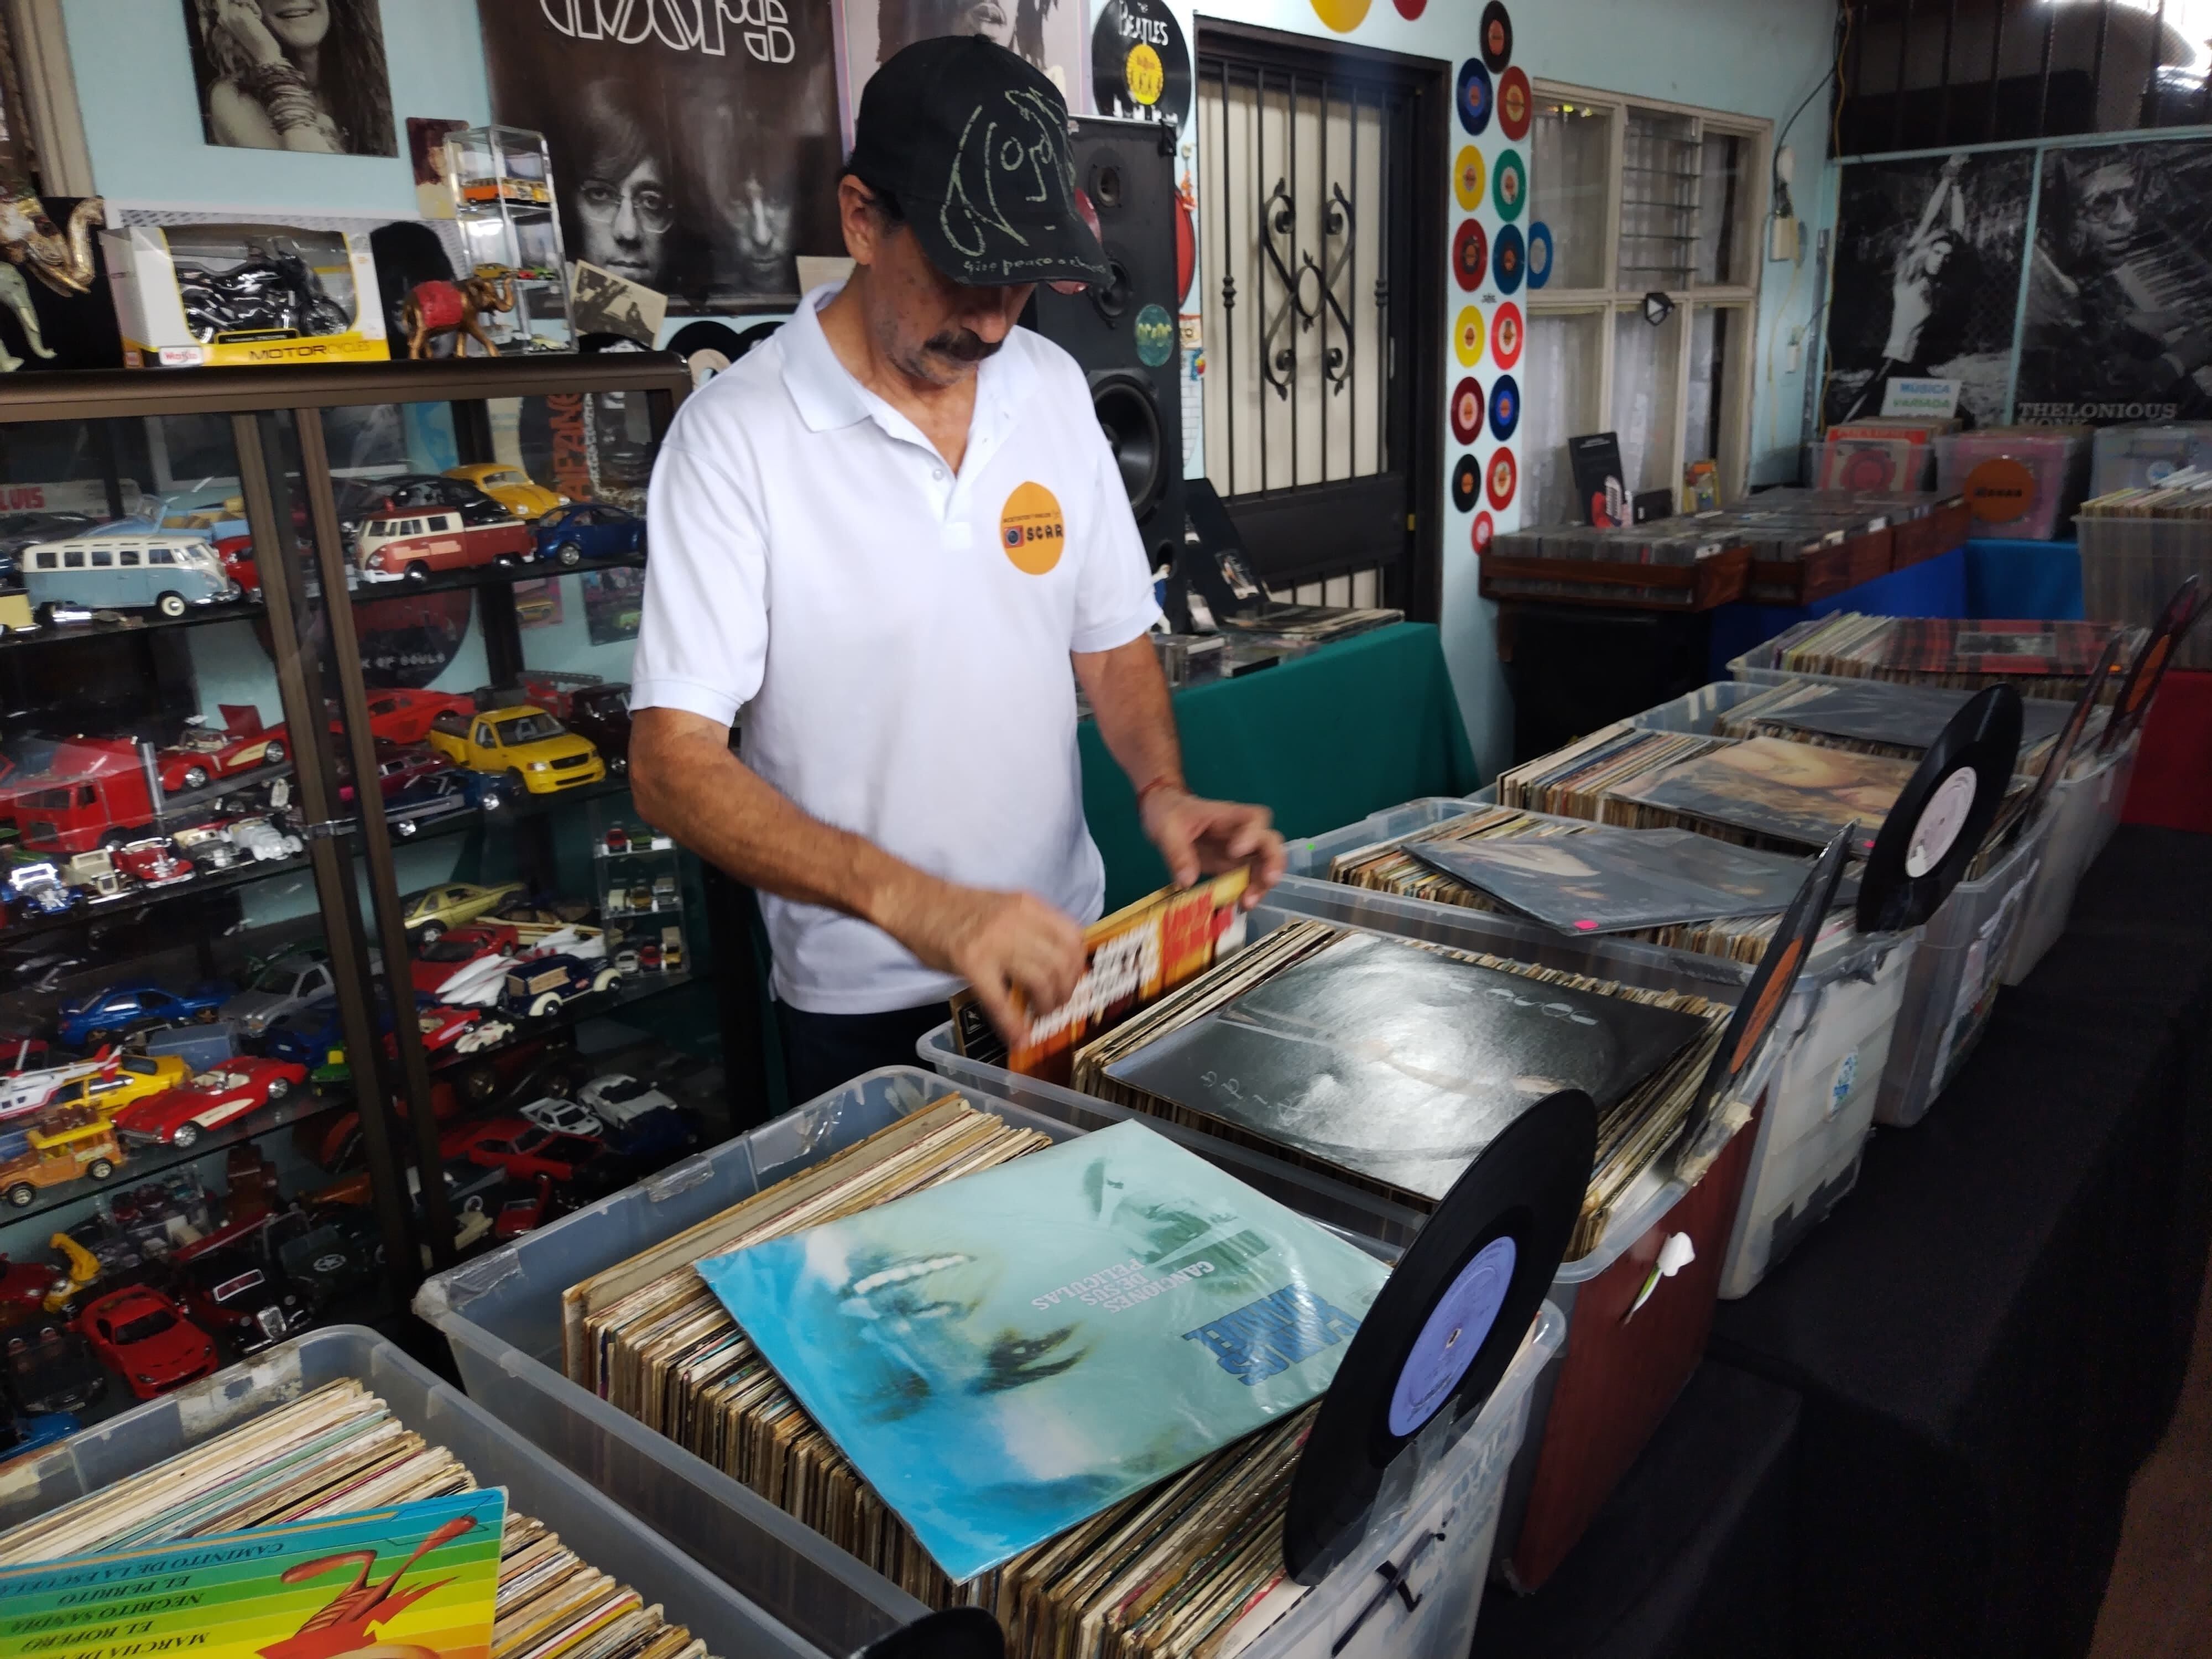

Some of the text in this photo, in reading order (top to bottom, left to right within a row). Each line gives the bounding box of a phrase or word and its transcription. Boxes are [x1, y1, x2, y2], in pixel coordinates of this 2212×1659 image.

[249, 340, 371, 361] MOTORCYCLES
[2018, 401, 2178, 420] THELONIOUS
[1030, 1257, 1146, 1311] PELICULAS
[1079, 1271, 1149, 1306] DE SUS
[1102, 1260, 1215, 1314] CANCIONES
[139, 1559, 167, 1574] DE
[171, 1541, 284, 1568] CAMINITO
[103, 1565, 134, 1580] LA
[58, 1575, 191, 1606] EL PERRITO
[98, 1592, 205, 1618] NEGRITO
[20, 1620, 154, 1653] EL ROPERO
[109, 1631, 210, 1658] MARCHA
